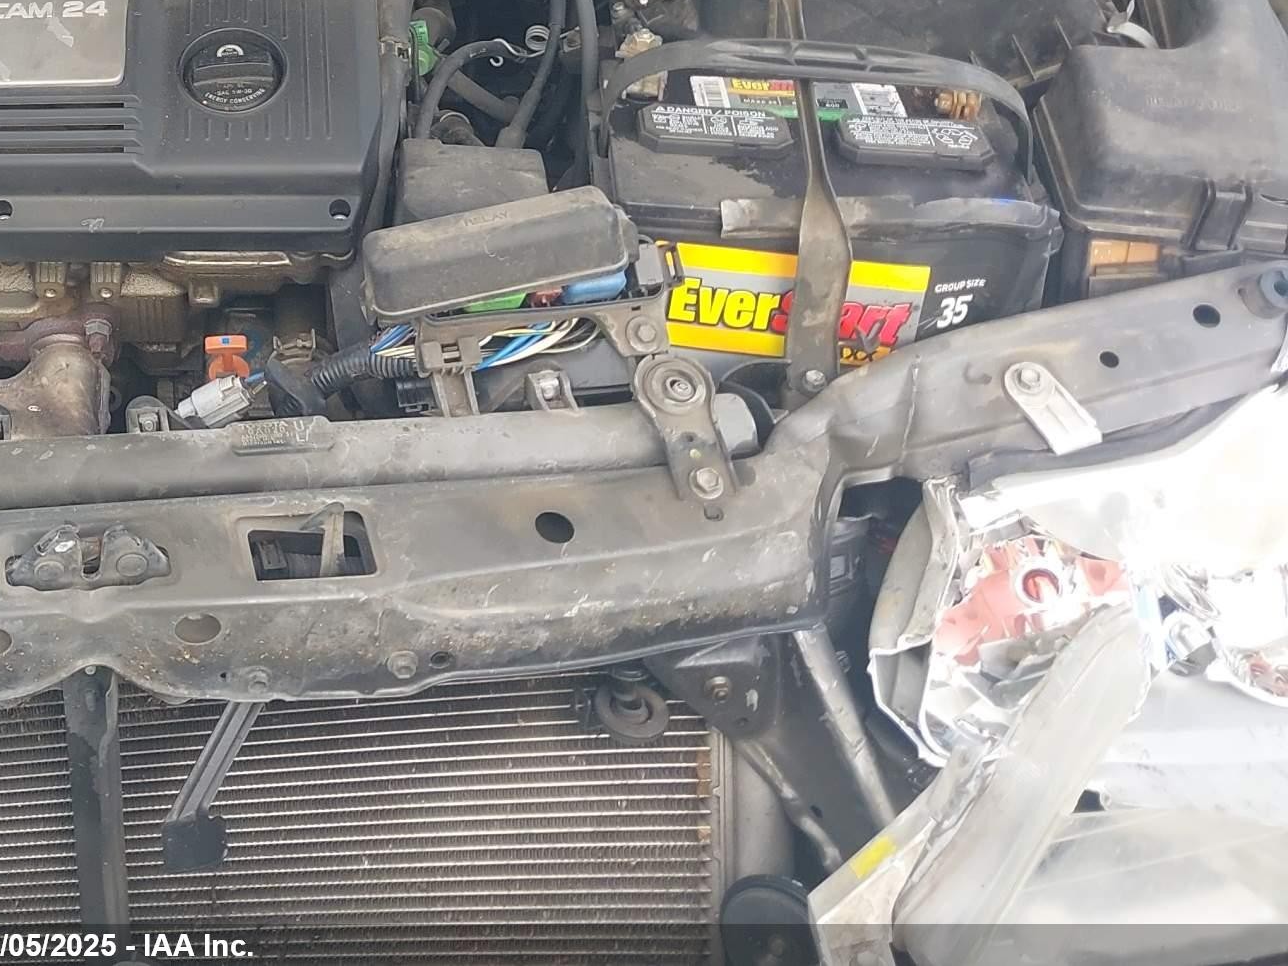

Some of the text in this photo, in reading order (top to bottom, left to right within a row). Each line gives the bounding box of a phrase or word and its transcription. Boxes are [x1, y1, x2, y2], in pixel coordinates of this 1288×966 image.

[61, 0, 109, 18] 24
[666, 105, 712, 115] DANGER
[724, 109, 766, 118] POISON
[934, 278, 987, 293] GROUP SIZE
[937, 294, 974, 328] 35
